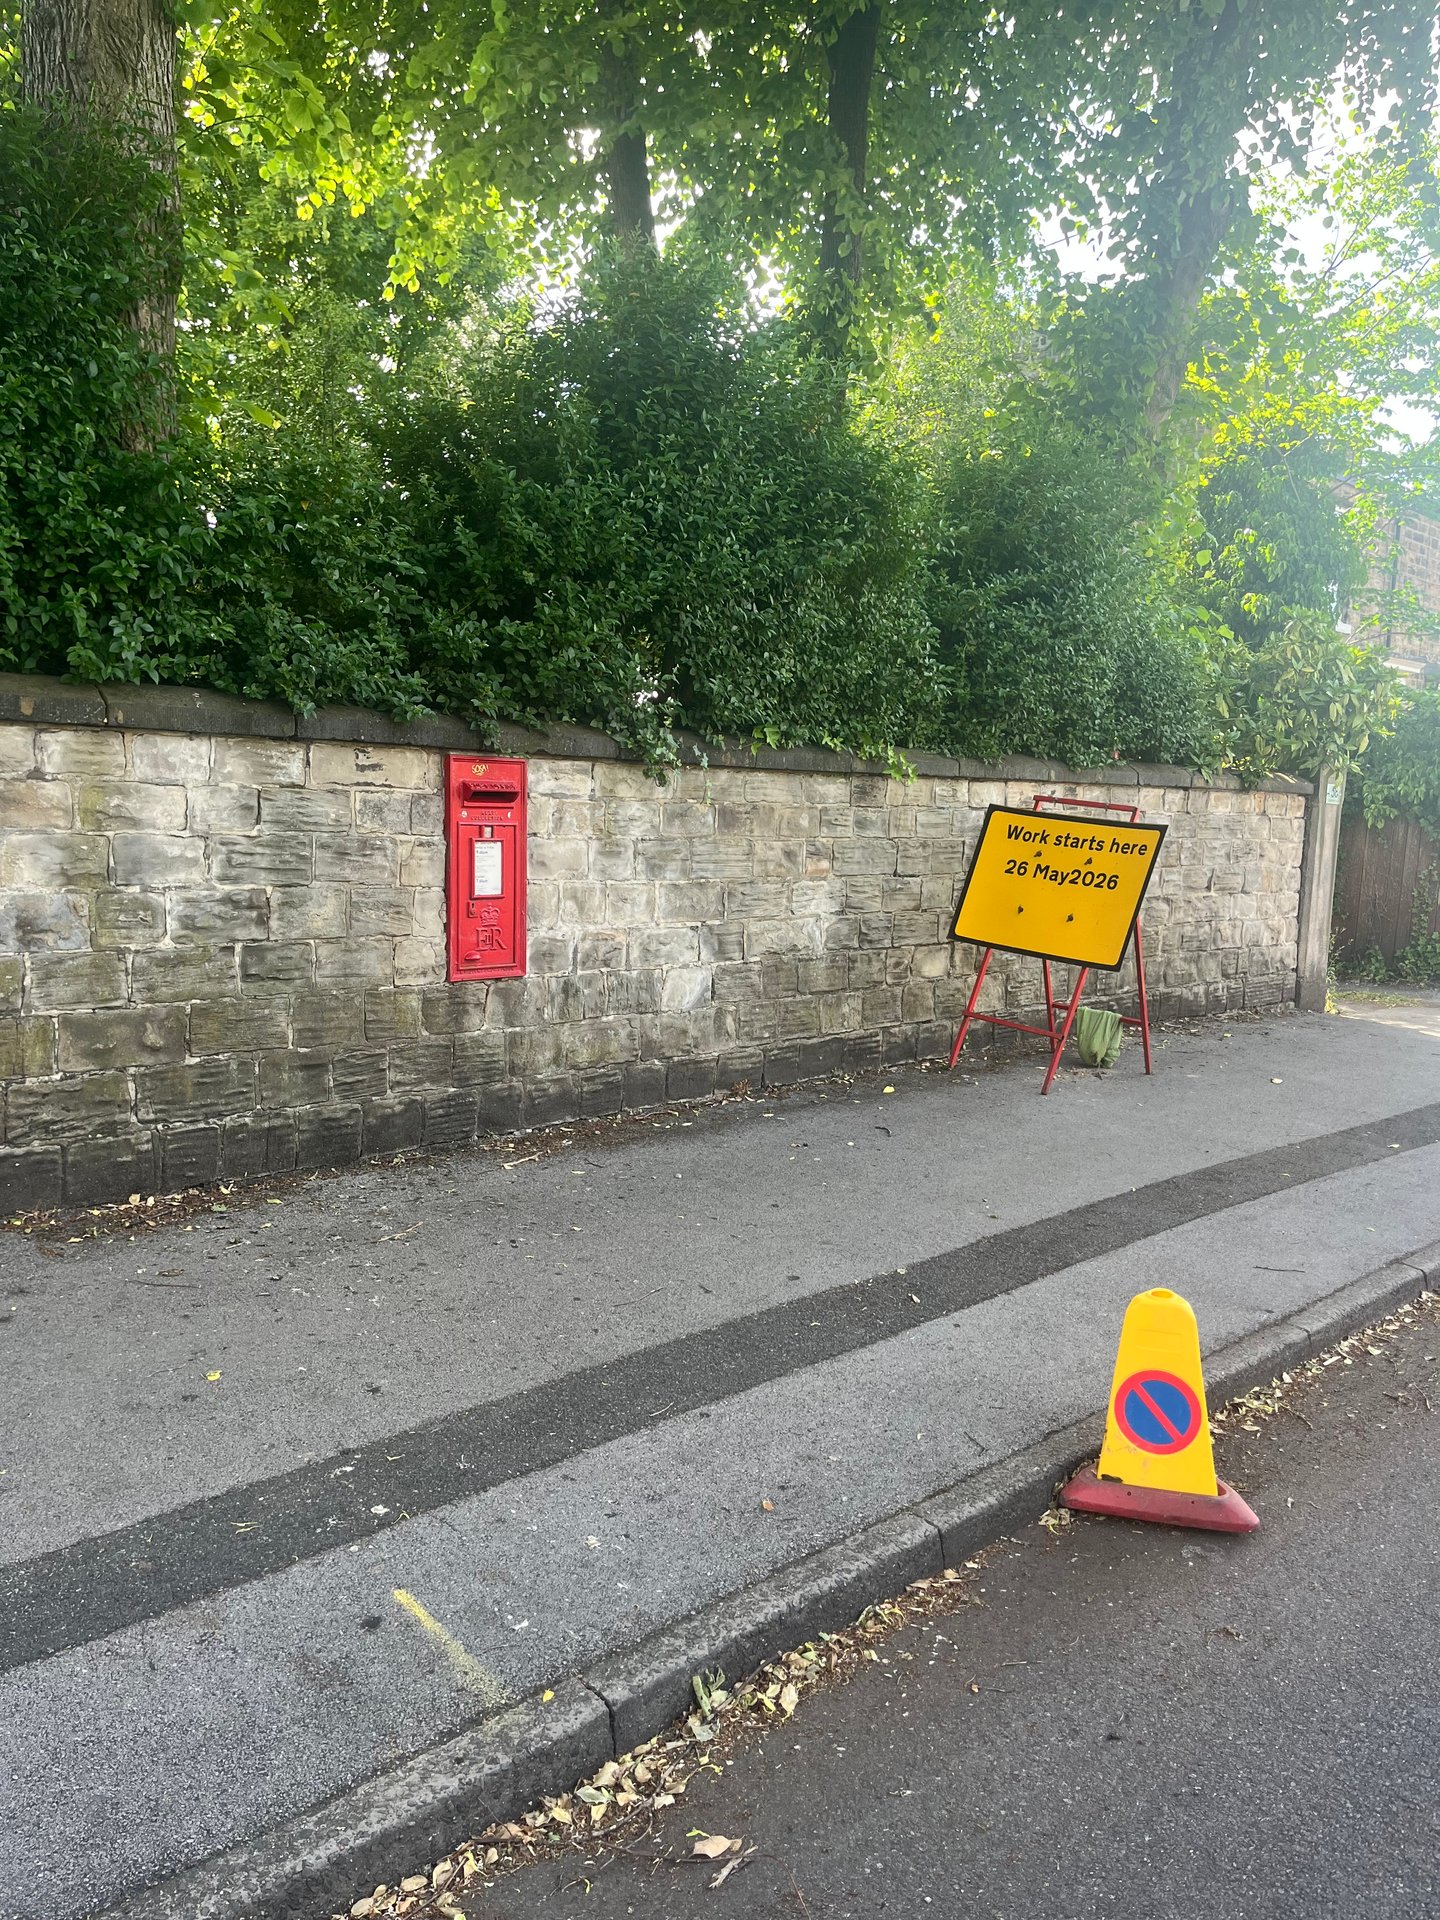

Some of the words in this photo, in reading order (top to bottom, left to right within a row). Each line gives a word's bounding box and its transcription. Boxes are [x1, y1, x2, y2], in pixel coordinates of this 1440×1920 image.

[1007, 824, 1050, 844] Work
[1053, 832, 1105, 852] starts
[1109, 837, 1148, 856] here
[1004, 859, 1029, 877] 26
[1032, 863, 1120, 890] May2026
